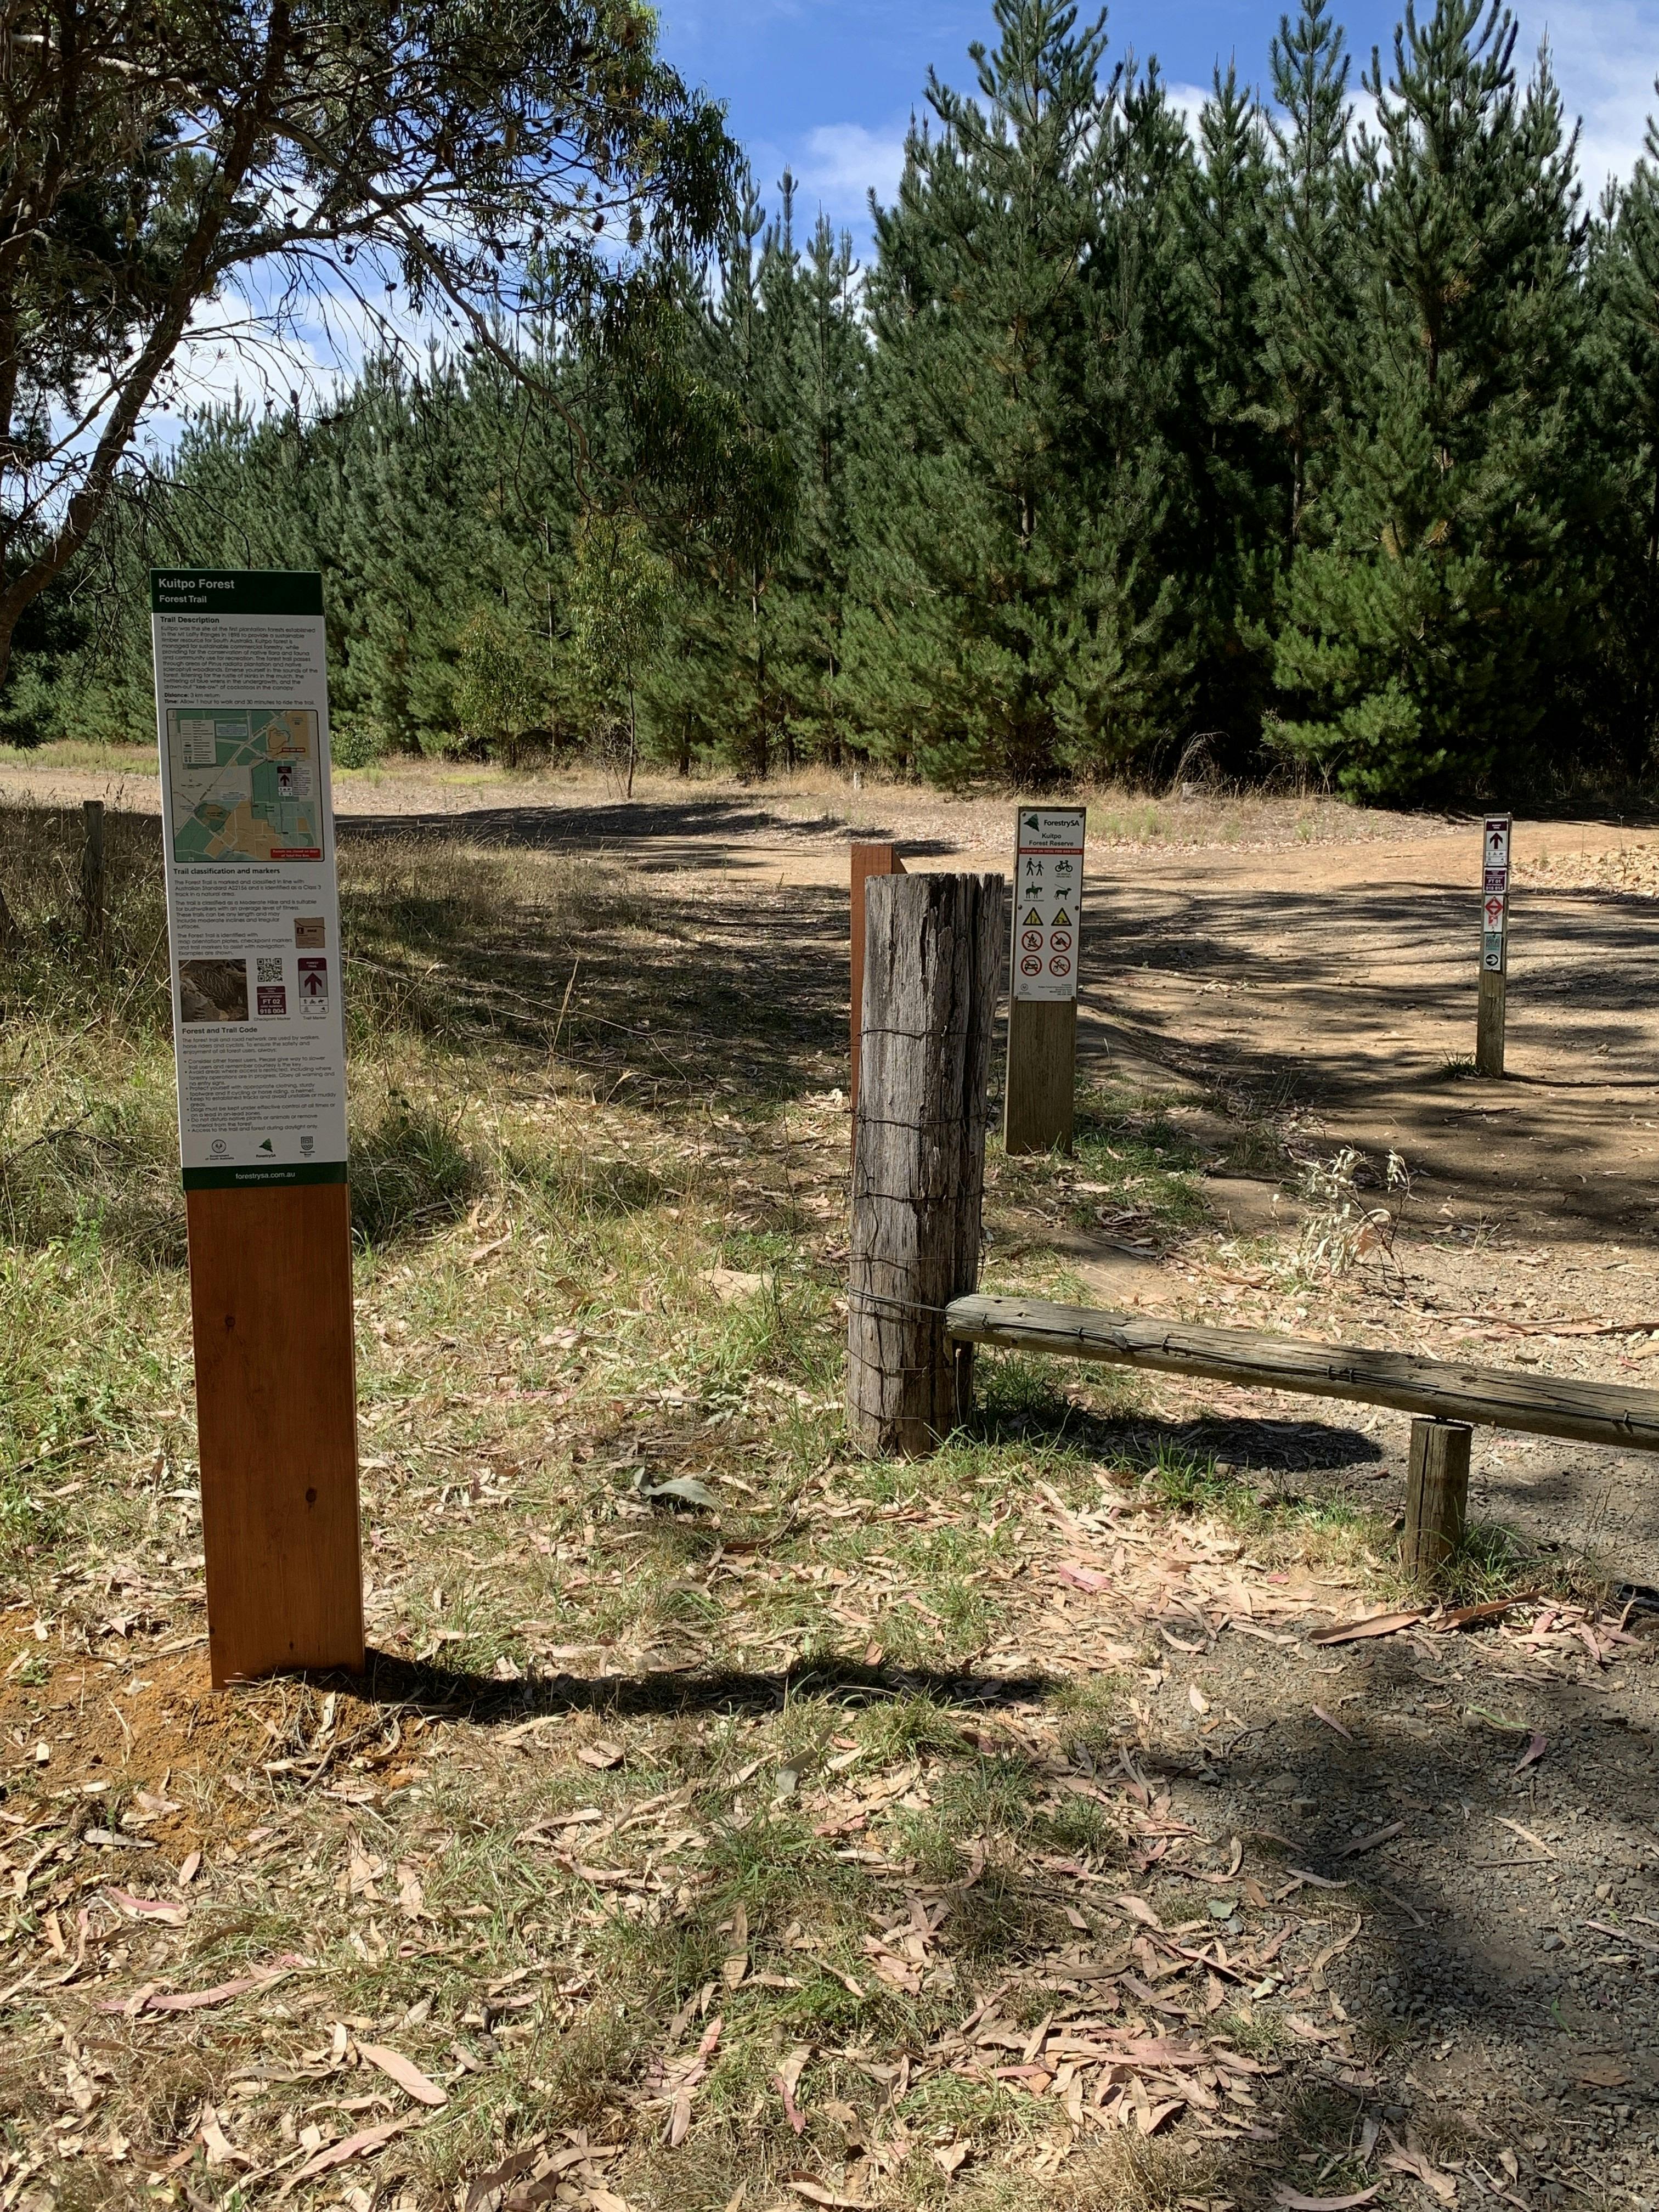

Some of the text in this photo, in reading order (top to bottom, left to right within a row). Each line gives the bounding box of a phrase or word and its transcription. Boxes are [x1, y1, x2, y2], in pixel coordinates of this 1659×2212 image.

[159, 578, 235, 590] Kuitpo Forest
[159, 595, 207, 603] Forest Trail
[236, 1172, 295, 1180] forestrysa.com.au
